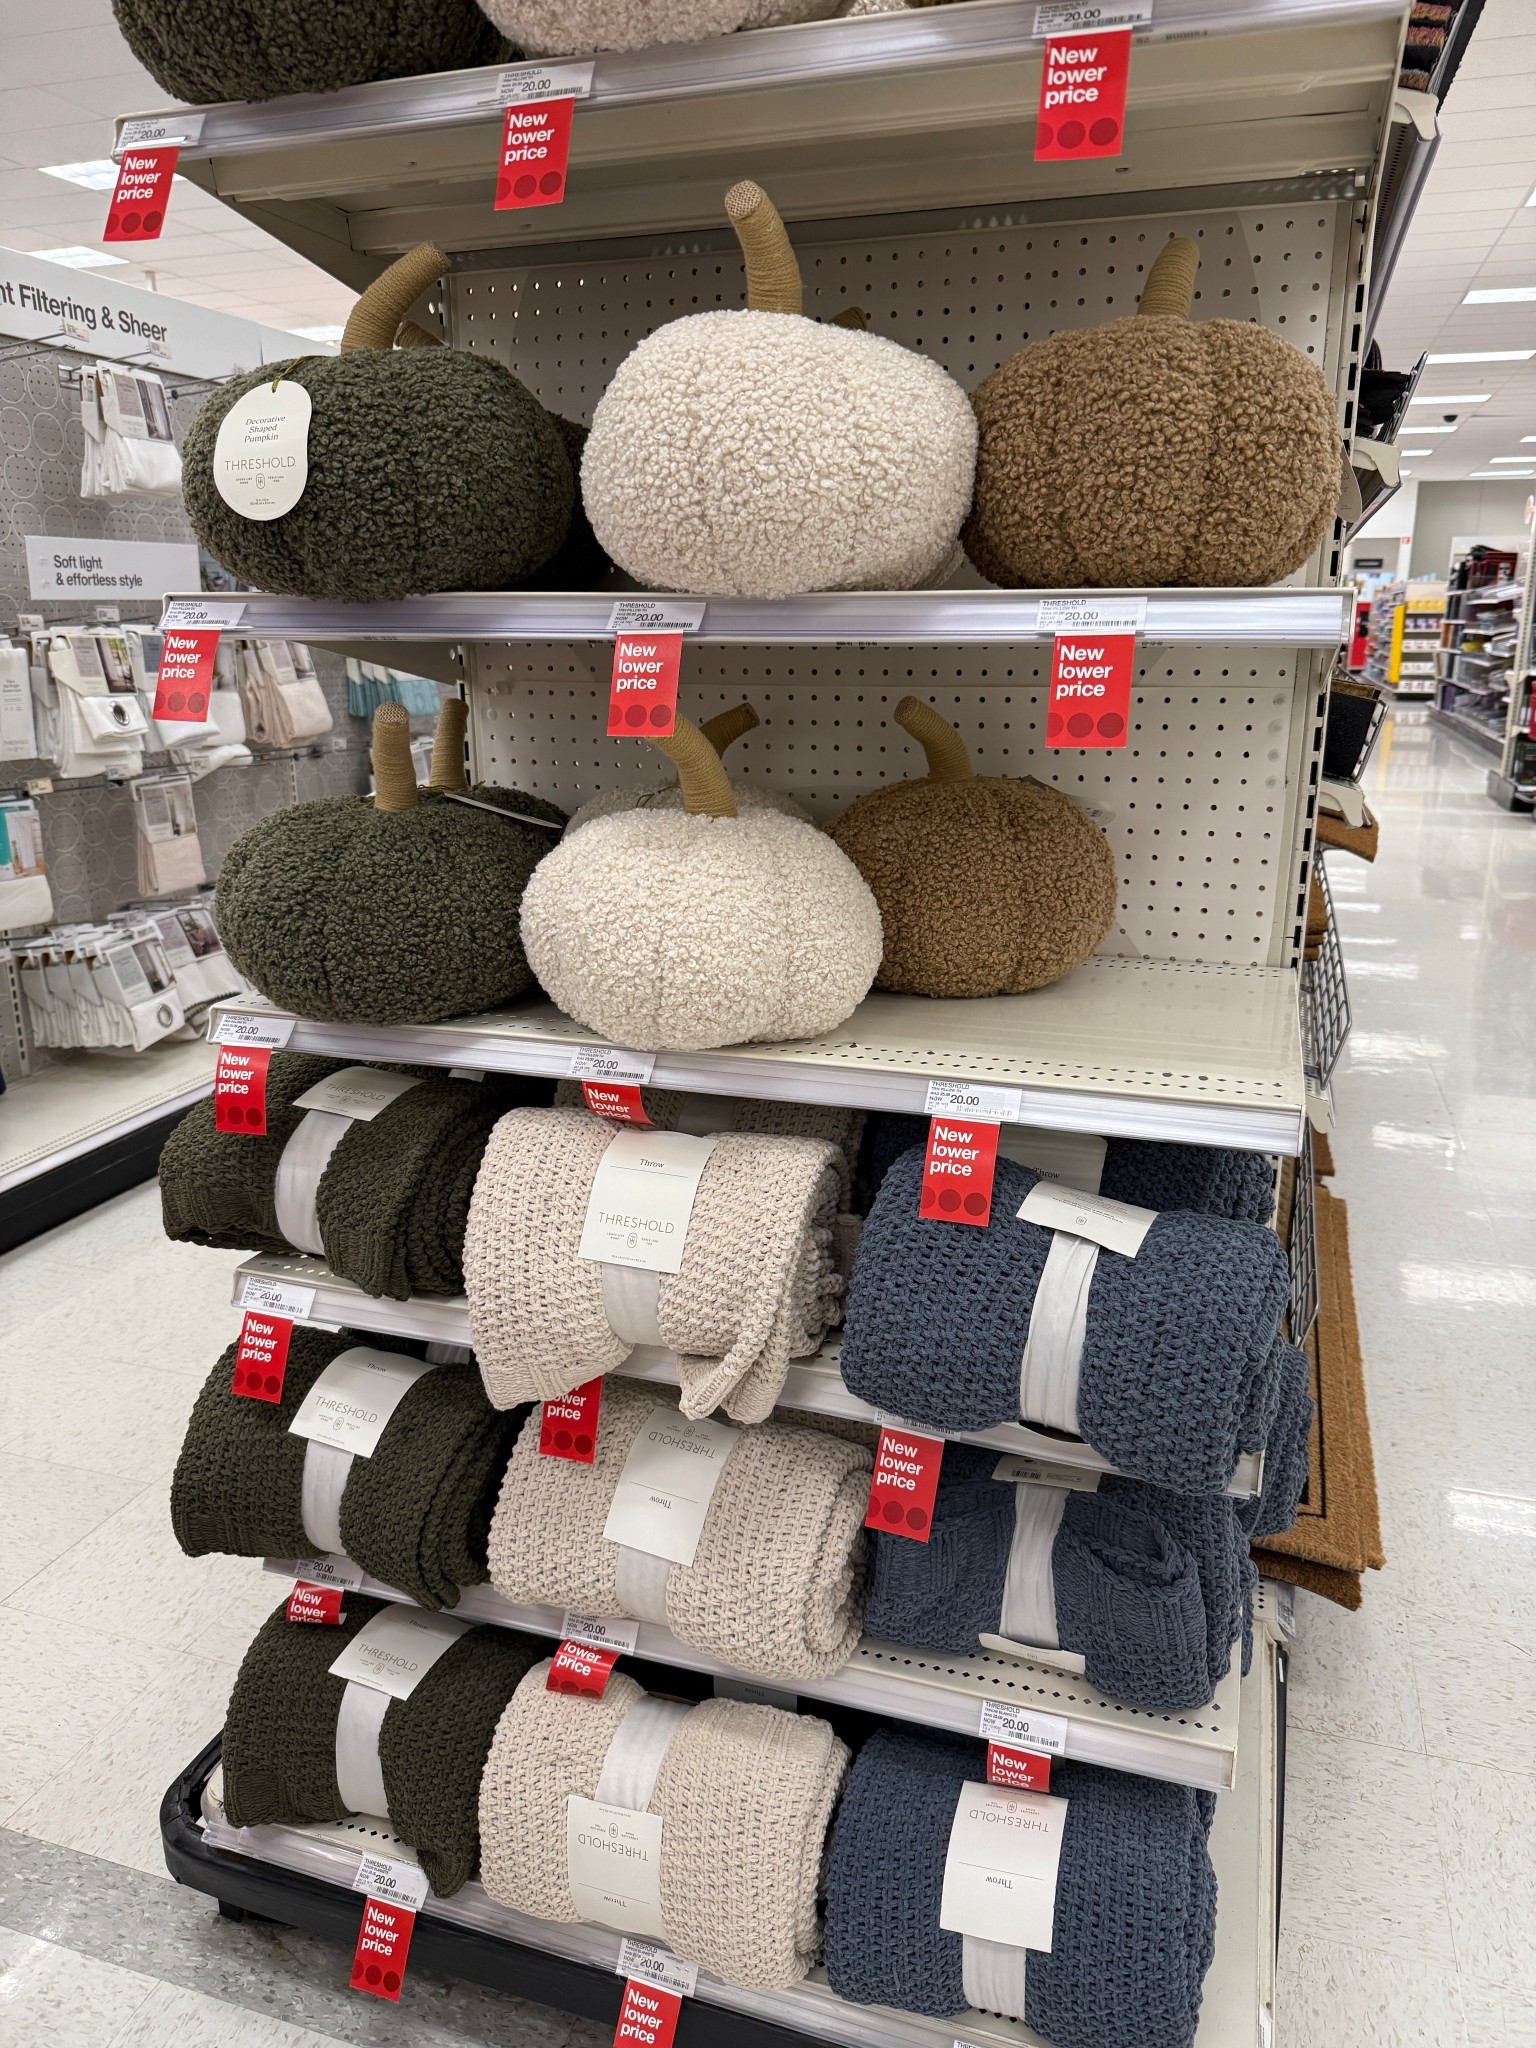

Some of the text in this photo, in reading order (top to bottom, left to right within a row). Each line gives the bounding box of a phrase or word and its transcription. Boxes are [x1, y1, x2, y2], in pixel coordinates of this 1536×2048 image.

[1064, 9, 1101, 22] 20.00
[1050, 47, 1098, 66] New
[1048, 66, 1107, 86] lower
[522, 79, 550, 91] 20.00
[1045, 86, 1099, 109] price
[509, 112, 548, 129] New
[140, 128, 166, 140] 20.00
[507, 128, 555, 146] lower
[124, 156, 158, 170] New
[504, 145, 548, 165] price
[121, 172, 161, 188] lower
[116, 187, 154, 203] price
[19, 284, 96, 331] Filtering
[102, 308, 116, 330] &
[119, 310, 167, 343] Sheer
[246, 416, 286, 426] Decorative
[248, 424, 278, 434] Shaped
[244, 433, 278, 443] Pumpkin
[224, 456, 296, 471] THRESHOLD
[54, 554, 103, 572] Soft light
[56, 573, 143, 589] & effortless style
[183, 612, 208, 620] 20.00
[634, 613, 664, 622] 20.00
[1064, 612, 1099, 621] 20.00
[168, 636, 198, 650] New
[620, 642, 657, 658] New
[164, 650, 202, 664] lower
[1060, 645, 1104, 661] New
[161, 666, 196, 681] price
[618, 658, 664, 674] lower
[1058, 663, 1114, 679] lower
[616, 674, 657, 693] price
[1056, 682, 1106, 700] price
[236, 1025, 259, 1035] 20.00
[579, 1047, 612, 1055] THRESHOLD
[221, 1052, 250, 1067] New
[592, 1059, 618, 1070] 20.00
[218, 1068, 254, 1083] lower
[218, 1082, 248, 1098] price
[326, 1083, 386, 1102] THRESHOLD
[931, 1081, 970, 1090] THRESHOLD
[588, 1088, 620, 1103] New
[950, 1094, 980, 1106] 20.00
[590, 1100, 630, 1113] lower
[934, 1126, 974, 1144] New
[932, 1143, 980, 1162] lower
[639, 1158, 665, 1170] Throw
[930, 1160, 972, 1178] price
[598, 1212, 675, 1234] THRESHOLD
[260, 1291, 282, 1302] 20.00
[246, 1319, 274, 1335] New
[244, 1332, 278, 1350] lower
[241, 1348, 272, 1363] price
[367, 1363, 388, 1374] Throw
[552, 1394, 586, 1406] ower
[316, 1395, 378, 1424] THRESHOLD
[547, 1405, 582, 1420] price
[648, 1430, 716, 1460] THRESHOLD
[883, 1436, 918, 1459] New
[879, 1453, 924, 1476] lower
[876, 1470, 916, 1492] price
[648, 1495, 672, 1511] Throw
[312, 1562, 334, 1574] 20.00
[293, 1588, 322, 1605] New
[290, 1603, 327, 1618] lower
[582, 1622, 606, 1636] 20.00
[358, 1643, 418, 1672] THRESHOLD
[563, 1642, 602, 1664] lower
[556, 1653, 592, 1676] price
[986, 1702, 1020, 1714] THRESHOLD
[1002, 1718, 1030, 1733] 20.00
[992, 1752, 1028, 1771] New
[992, 1766, 1034, 1782] lower
[969, 1809, 1050, 1834] THRESHOLD
[577, 1833, 649, 1862] THRESHOLD
[364, 1858, 392, 1872] THRESHOLD
[374, 1874, 396, 1888] 20.00
[986, 1876, 1013, 1890] Throw
[603, 1895, 628, 1908] Throw
[368, 1906, 396, 1927] New
[364, 1921, 400, 1944] lower
[361, 1938, 392, 1958] price
[626, 1939, 658, 1954] THRESHOLD
[640, 1957, 665, 1972] 20.00
[628, 1988, 659, 2012] New
[624, 2004, 663, 2030] lower
[620, 2022, 656, 2044] price
